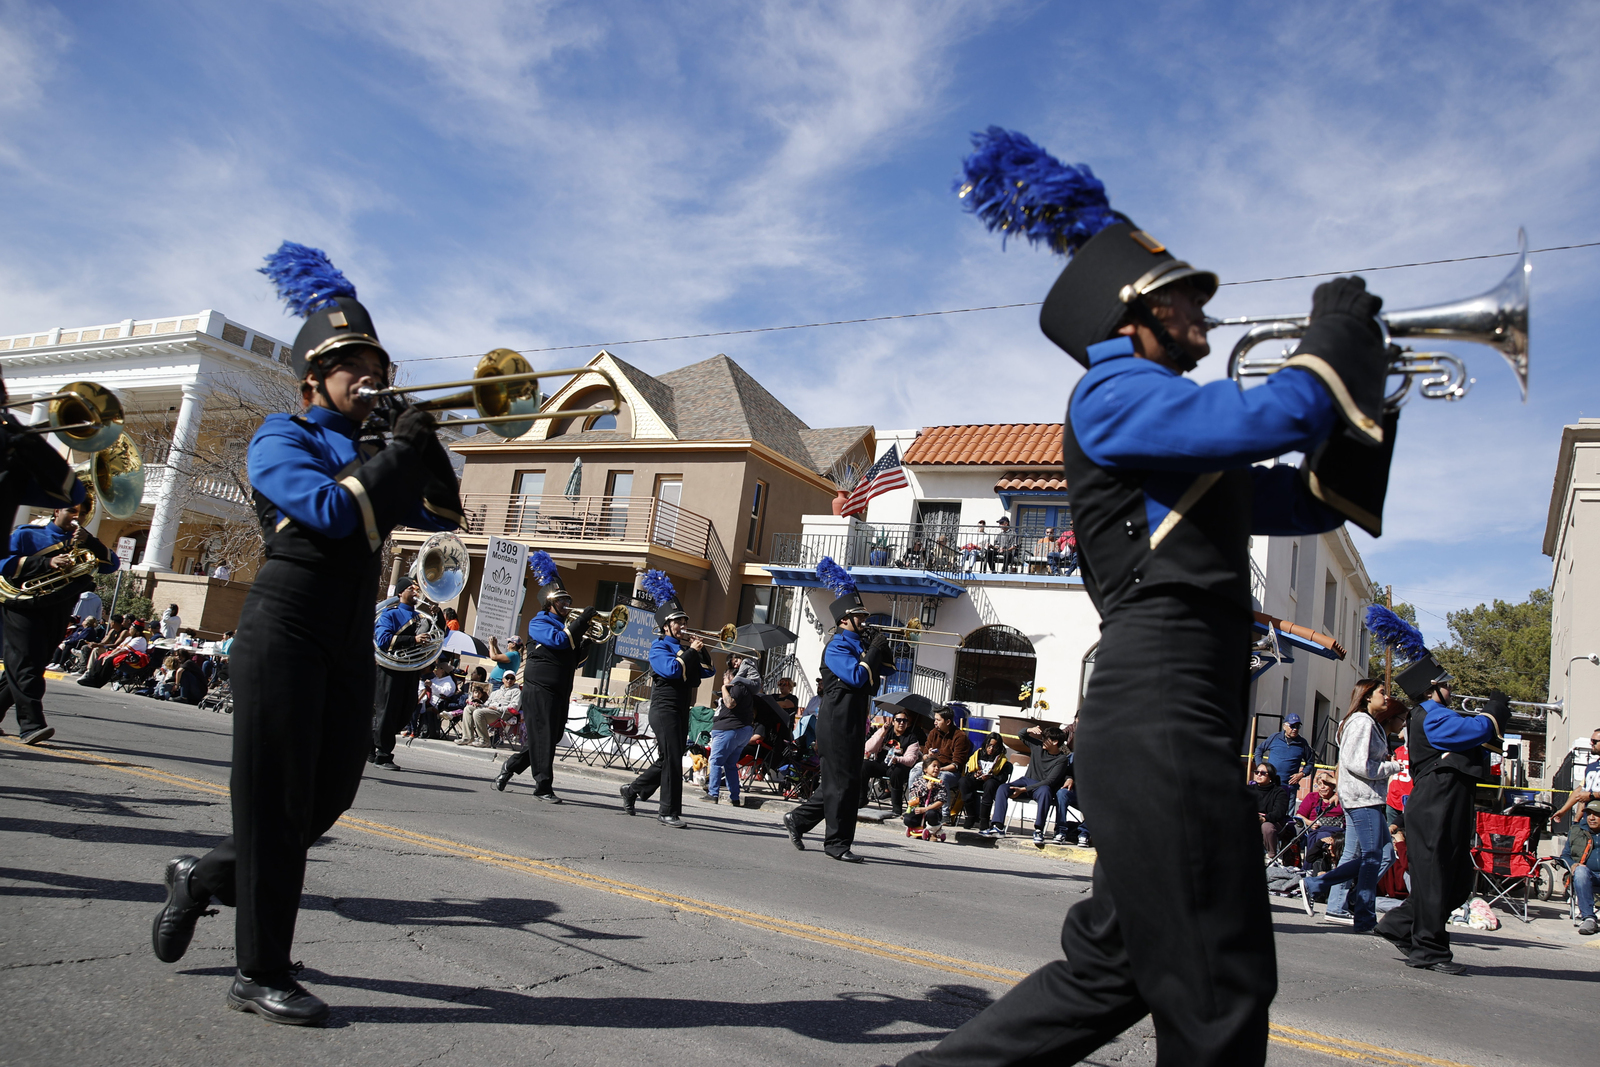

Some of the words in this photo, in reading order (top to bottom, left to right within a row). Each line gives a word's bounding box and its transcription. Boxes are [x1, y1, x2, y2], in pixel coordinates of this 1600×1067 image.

[496, 540, 518, 556] 1309
[492, 551, 518, 564] Montana
[484, 583, 503, 596] Vitality
[637, 590, 653, 601] 1315
